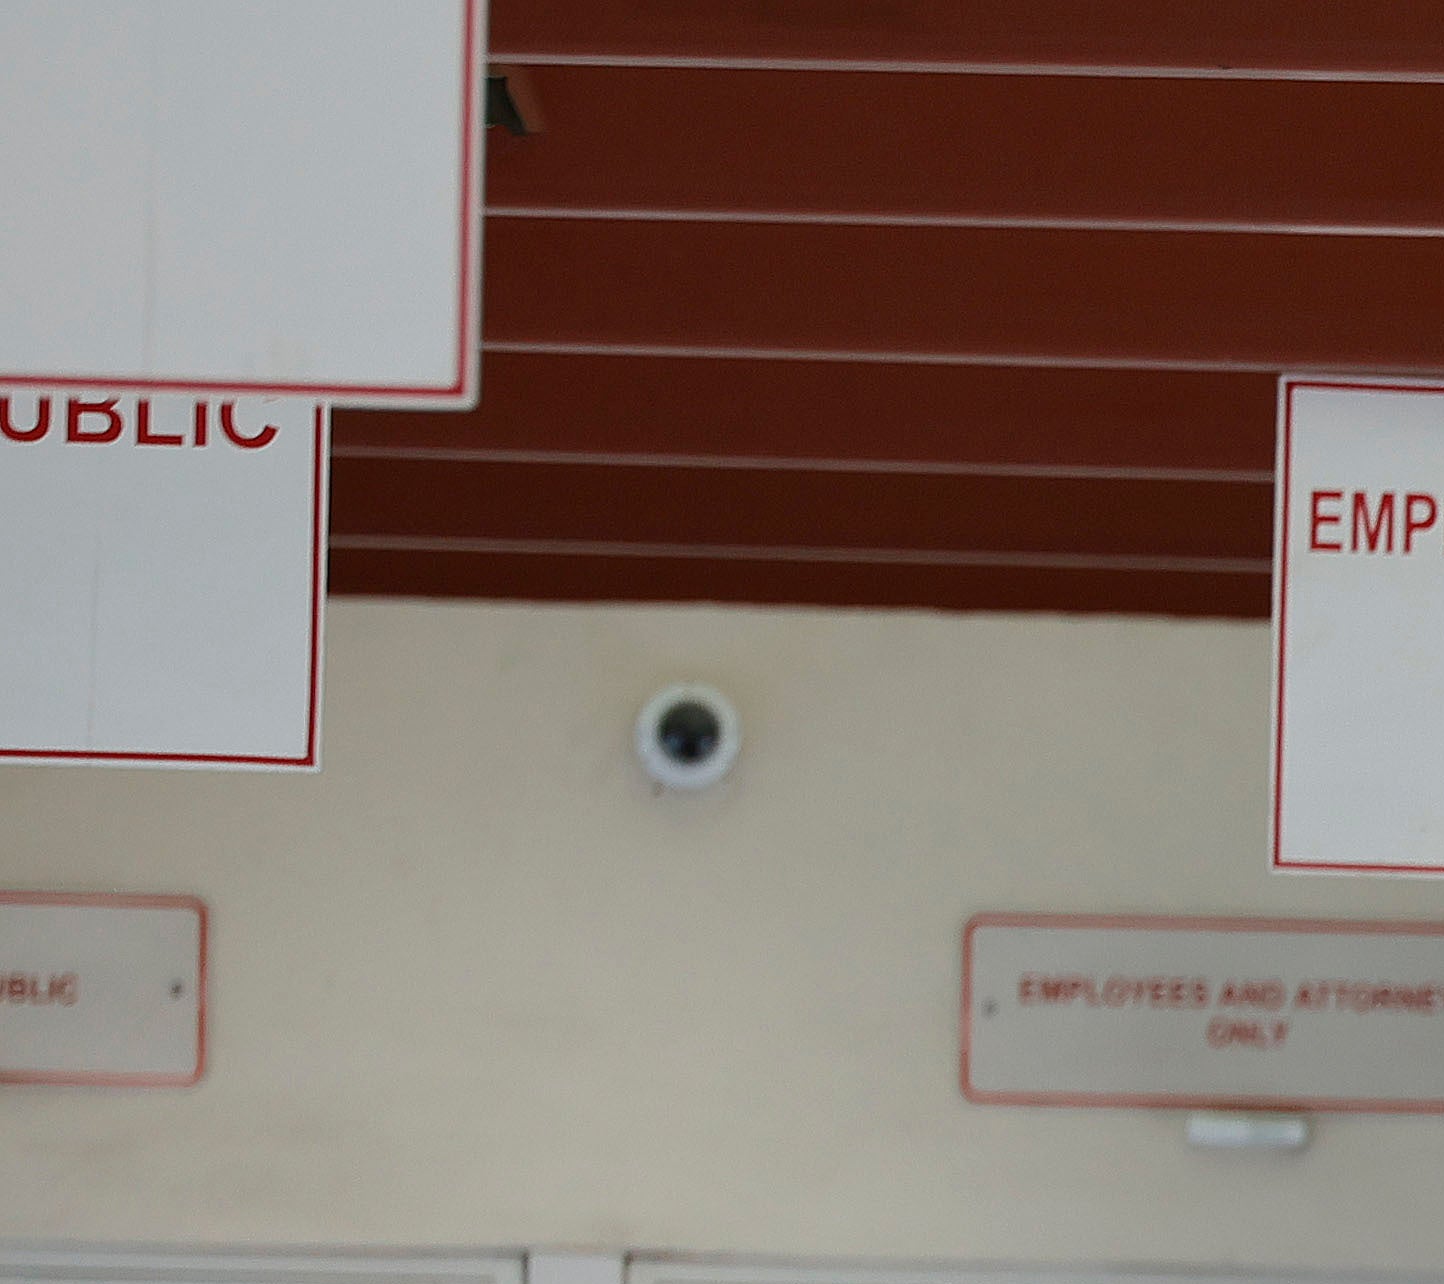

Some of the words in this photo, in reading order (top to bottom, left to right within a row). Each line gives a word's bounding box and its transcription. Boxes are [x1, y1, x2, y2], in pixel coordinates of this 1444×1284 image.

[0, 972, 79, 1006] BLIC
[1018, 973, 1206, 1009] EMPLOYEES
[1217, 978, 1287, 1012] AND
[1207, 1017, 1289, 1048] ONLY
